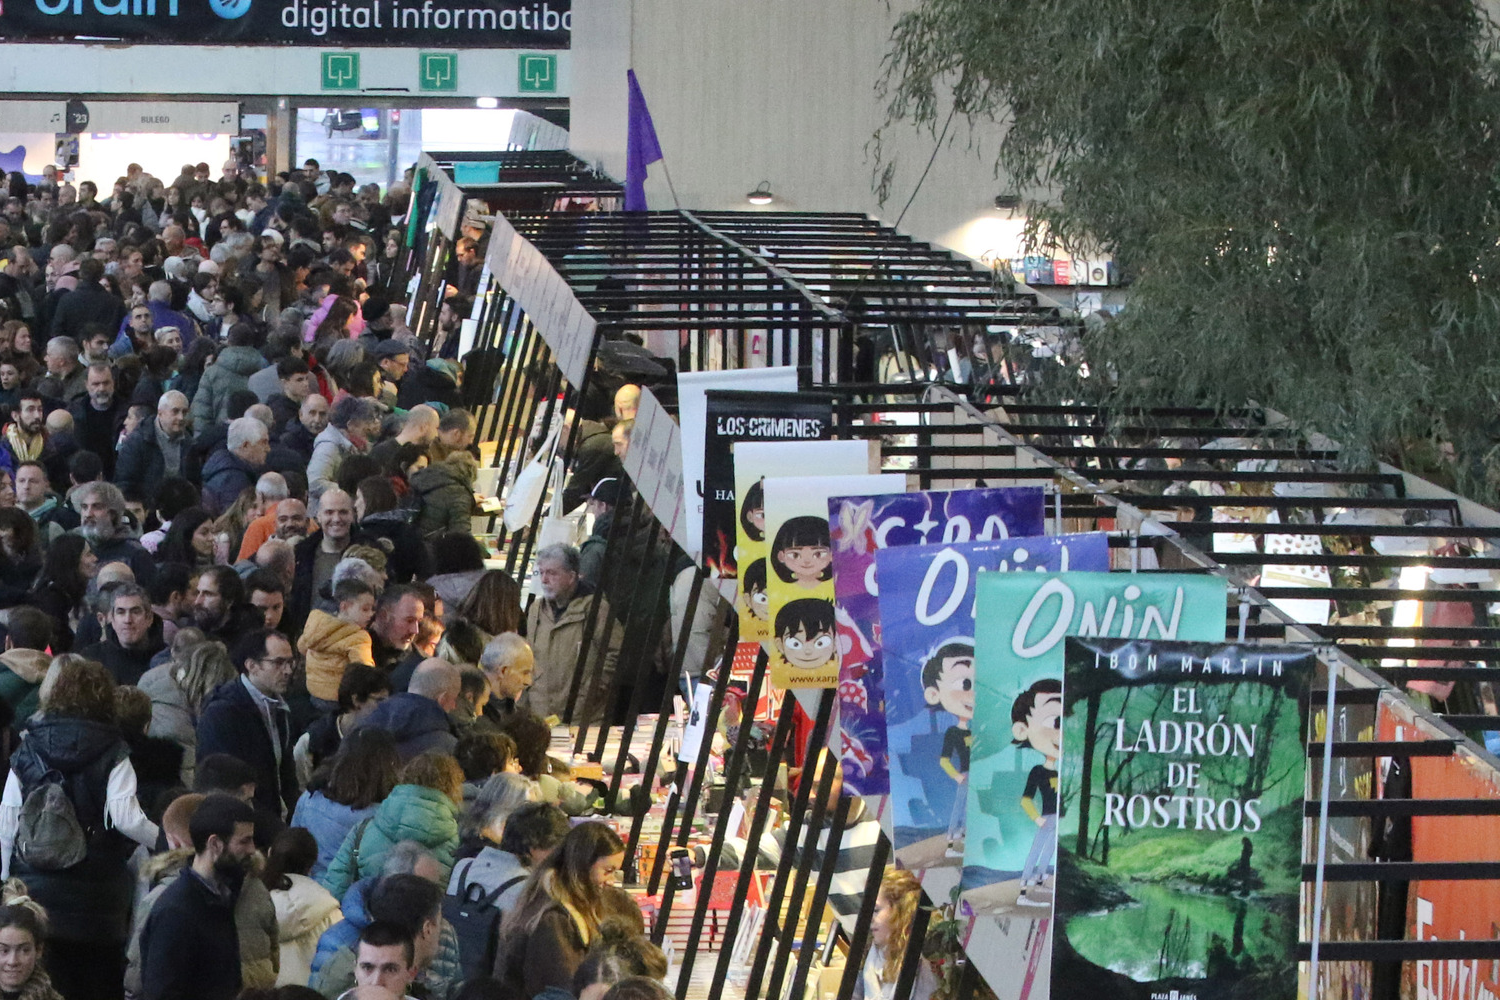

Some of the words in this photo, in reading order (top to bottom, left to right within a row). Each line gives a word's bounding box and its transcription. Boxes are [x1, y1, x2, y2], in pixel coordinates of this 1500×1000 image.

[281, 0, 381, 36] digital
[717, 417, 745, 436] LOS
[1095, 653, 1157, 672] IBON
[1181, 654, 1282, 676] MARTÍN
[1172, 687, 1202, 713] EL
[1115, 715, 1257, 757] LADRÓN
[1167, 762, 1201, 789] DE
[1104, 793, 1262, 832] ROSTROS
[1151, 992, 1168, 1000] PLAZA
